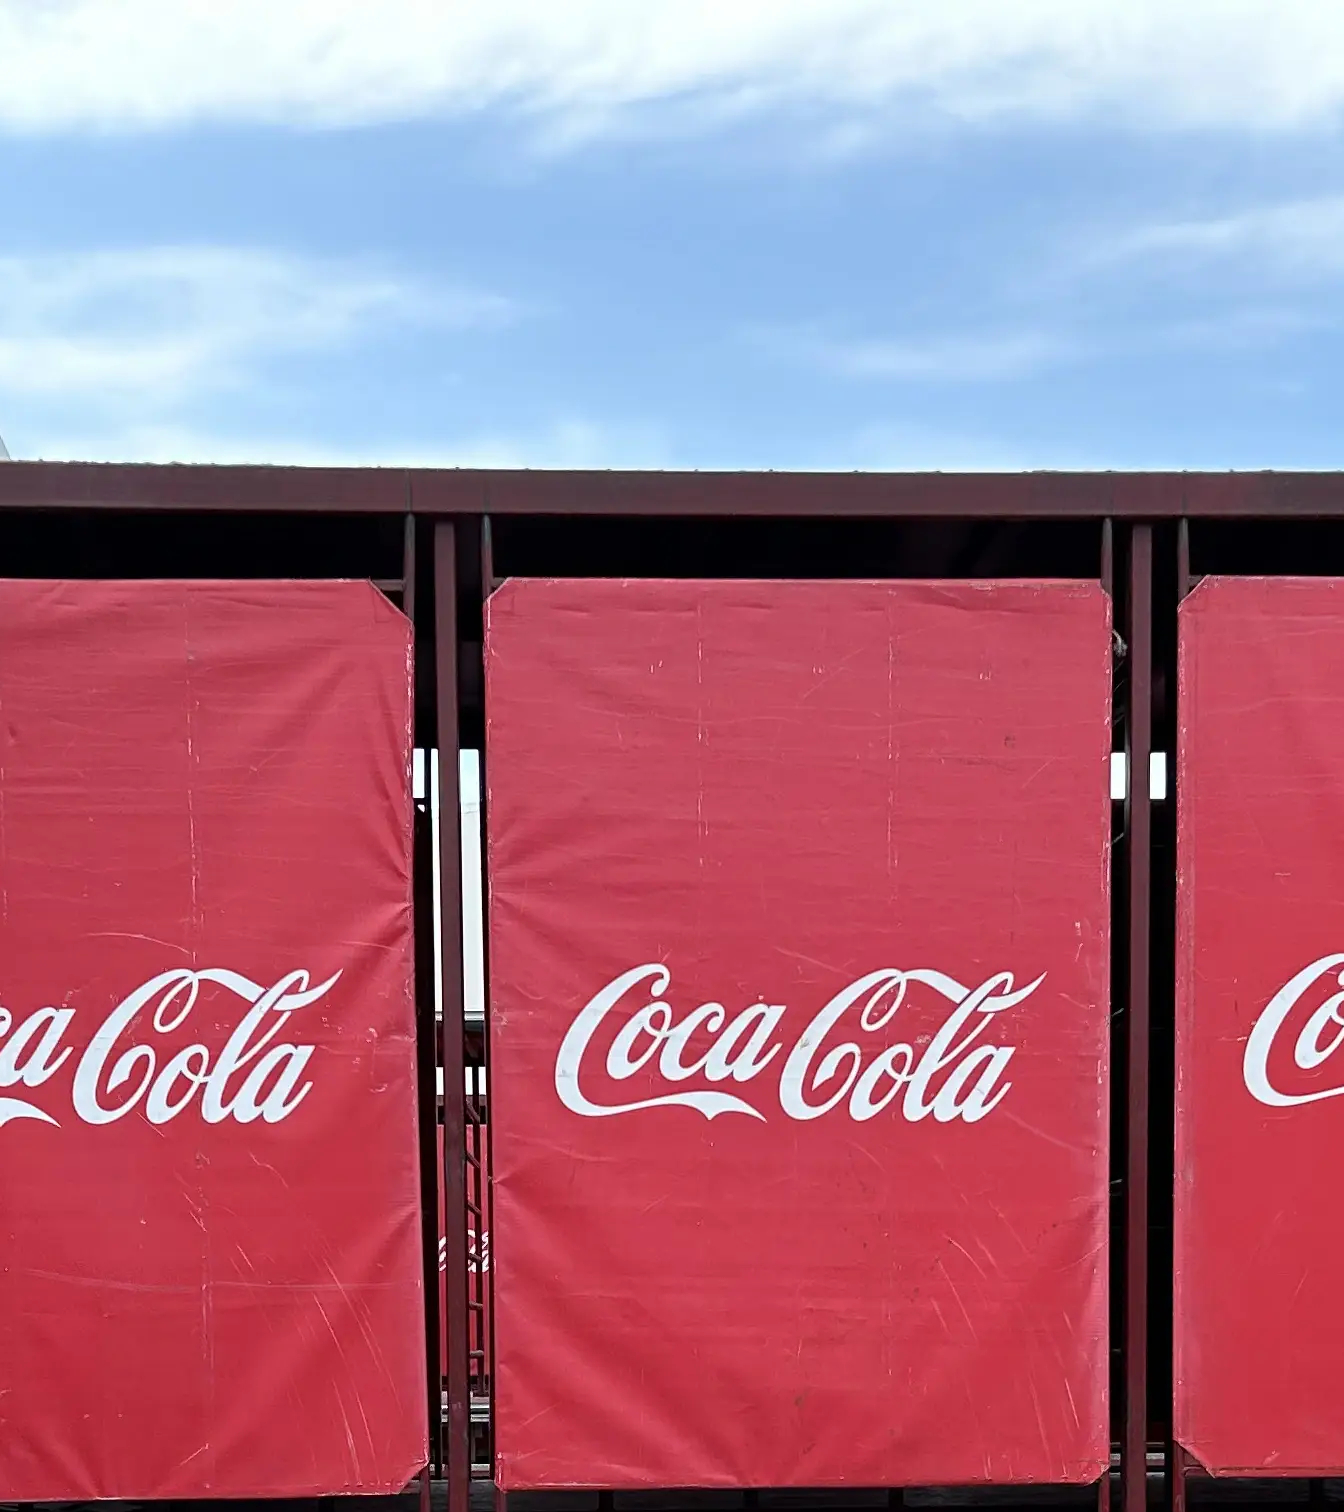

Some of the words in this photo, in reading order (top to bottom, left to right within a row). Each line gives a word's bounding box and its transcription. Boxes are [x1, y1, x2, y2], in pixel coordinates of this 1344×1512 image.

[72, 968, 344, 1125] Cola
[554, 963, 787, 1122] Coca
[779, 968, 1047, 1123] Cola
